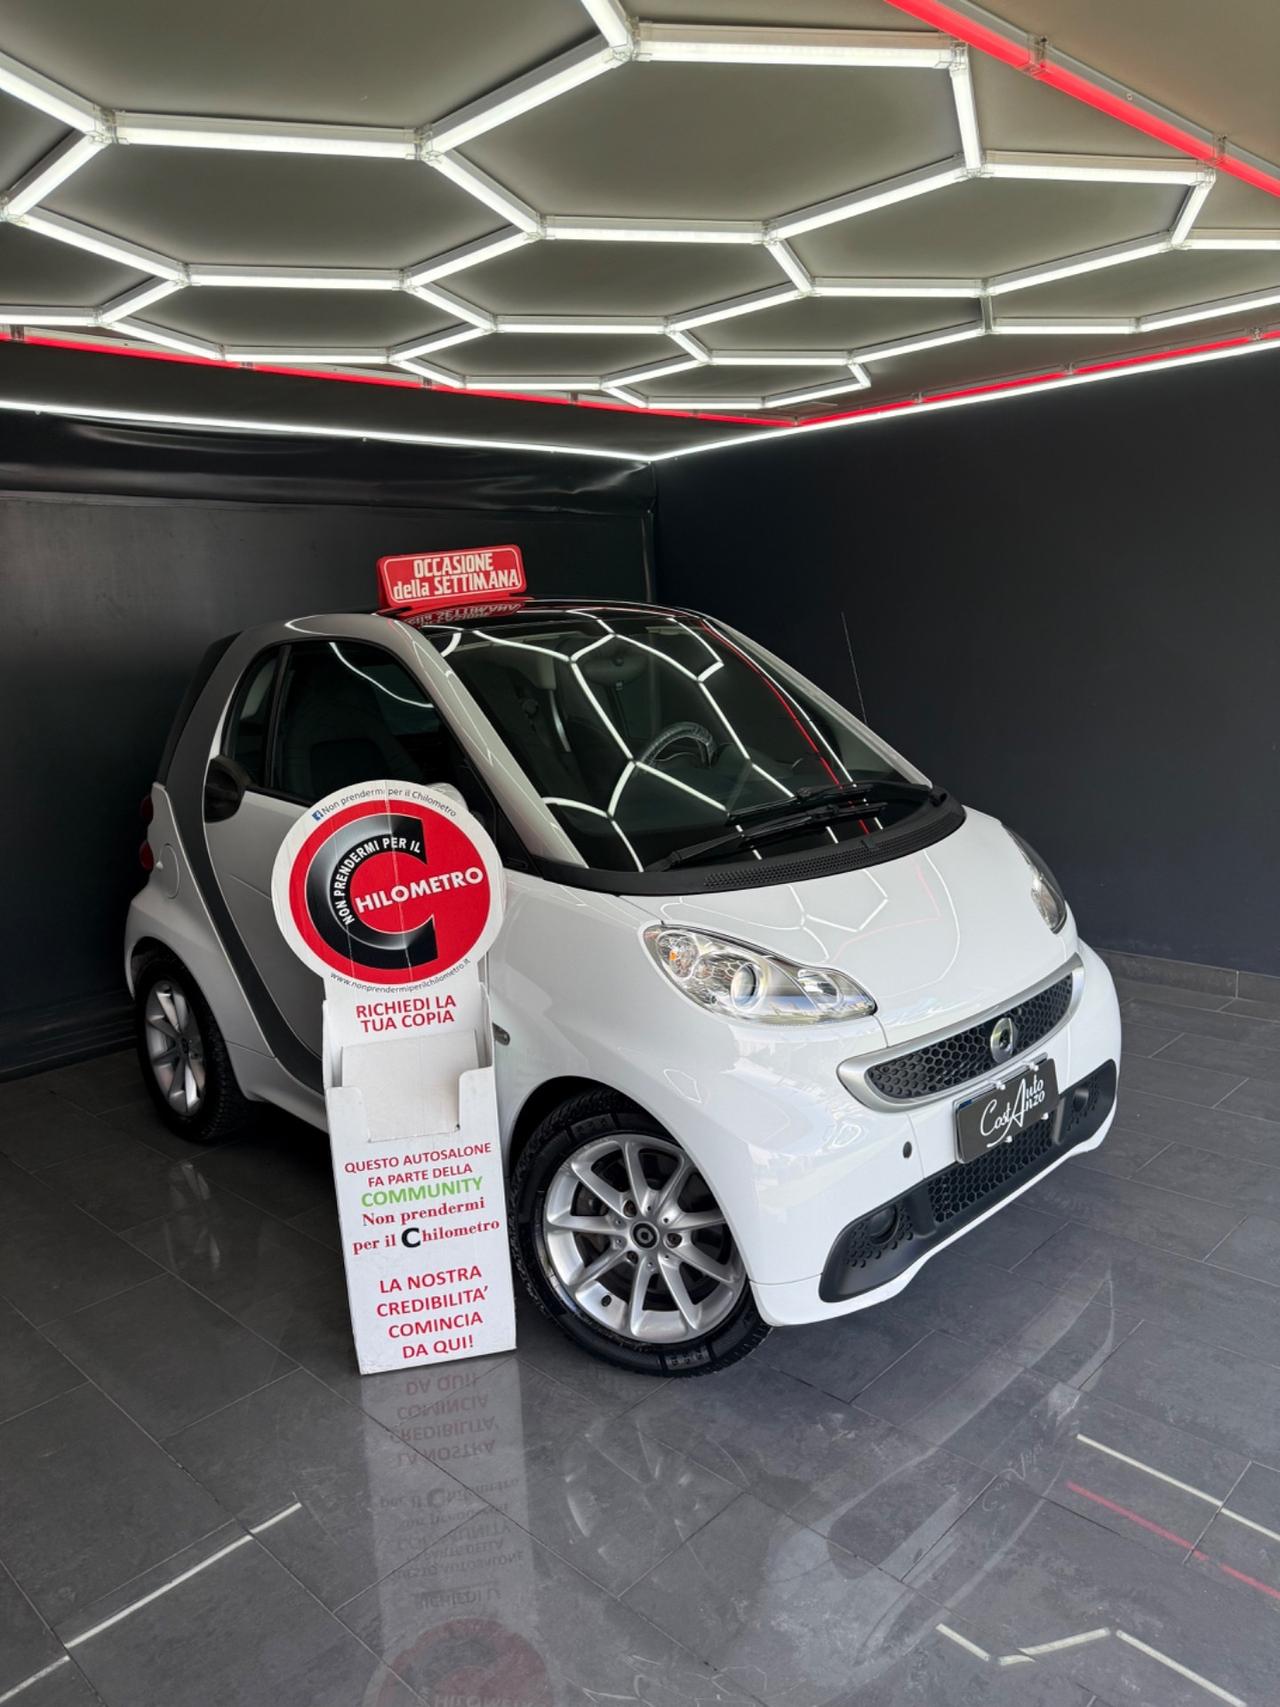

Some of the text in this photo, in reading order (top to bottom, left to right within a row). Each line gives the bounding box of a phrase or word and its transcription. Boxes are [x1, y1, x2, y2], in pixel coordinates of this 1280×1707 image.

[413, 552, 494, 579] OCCASIONE
[393, 569, 519, 600] della SETTIMANA
[321, 801, 340, 815] Non
[388, 788, 402, 796] per
[404, 788, 411, 797] il
[411, 790, 457, 817] Chilometro
[333, 837, 421, 926] NON PRENDERMI PER IL
[356, 994, 456, 1018] RICHIEDI LA
[361, 1009, 455, 1034] TUA COPIA
[344, 1143, 492, 1174] QUESTO AUTOSALONE
[368, 1163, 473, 1188] FA PARTE DELLA
[361, 1176, 483, 1207] COMMUNITY
[362, 1197, 485, 1226] Non prendermi
[352, 1220, 500, 1255] per il Chilometro
[380, 1265, 482, 1294] LA NOSTRA
[389, 1311, 483, 1338] COMINCIA
[403, 1334, 474, 1359] DA QUI!
